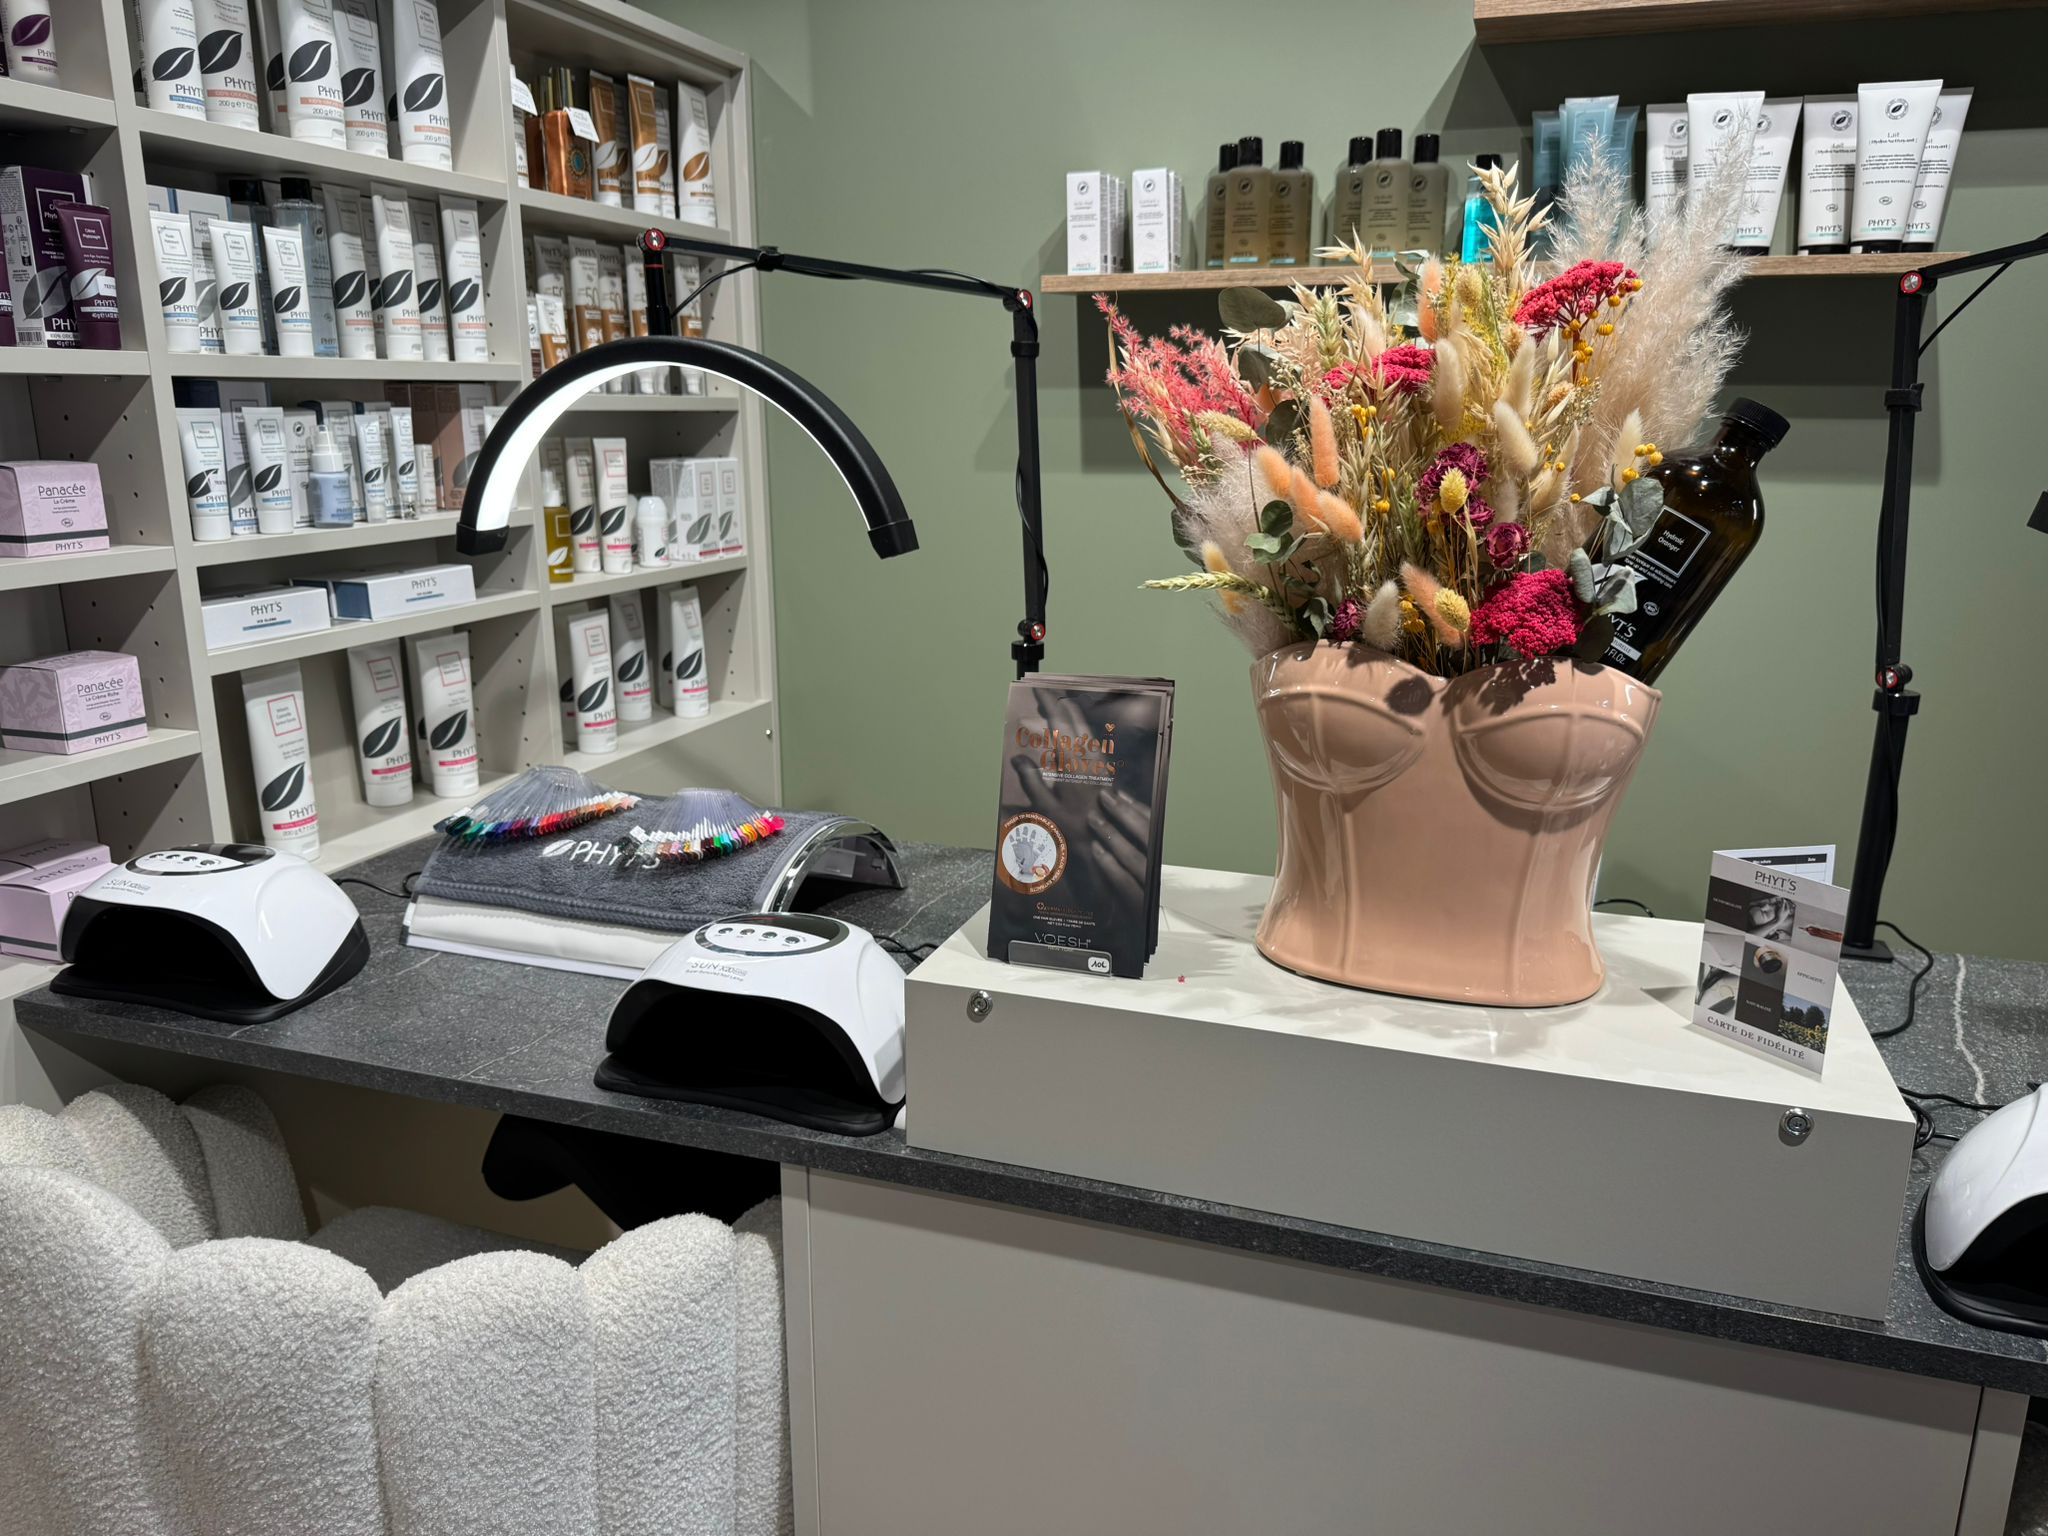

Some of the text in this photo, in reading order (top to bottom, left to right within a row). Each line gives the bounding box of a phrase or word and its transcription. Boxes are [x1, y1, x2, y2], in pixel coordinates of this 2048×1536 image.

[38, 483, 87, 497] Panacée
[55, 541, 84, 551] PHYT'S
[1657, 536, 1681, 553] Oranger
[411, 580, 437, 593] PHYT'S
[250, 601, 282, 616] PHYT'S
[76, 677, 124, 695] Panacée
[94, 732, 121, 745] PHYT'S
[1015, 726, 1115, 759] Collagen
[1041, 750, 1117, 776] Gloves
[1754, 870, 1798, 892] PHYT'S
[1034, 932, 1090, 949] VOESH
[691, 962, 720, 971] SUN
[1707, 1015, 1806, 1060] CARTE DE FIDÉLITÉ
